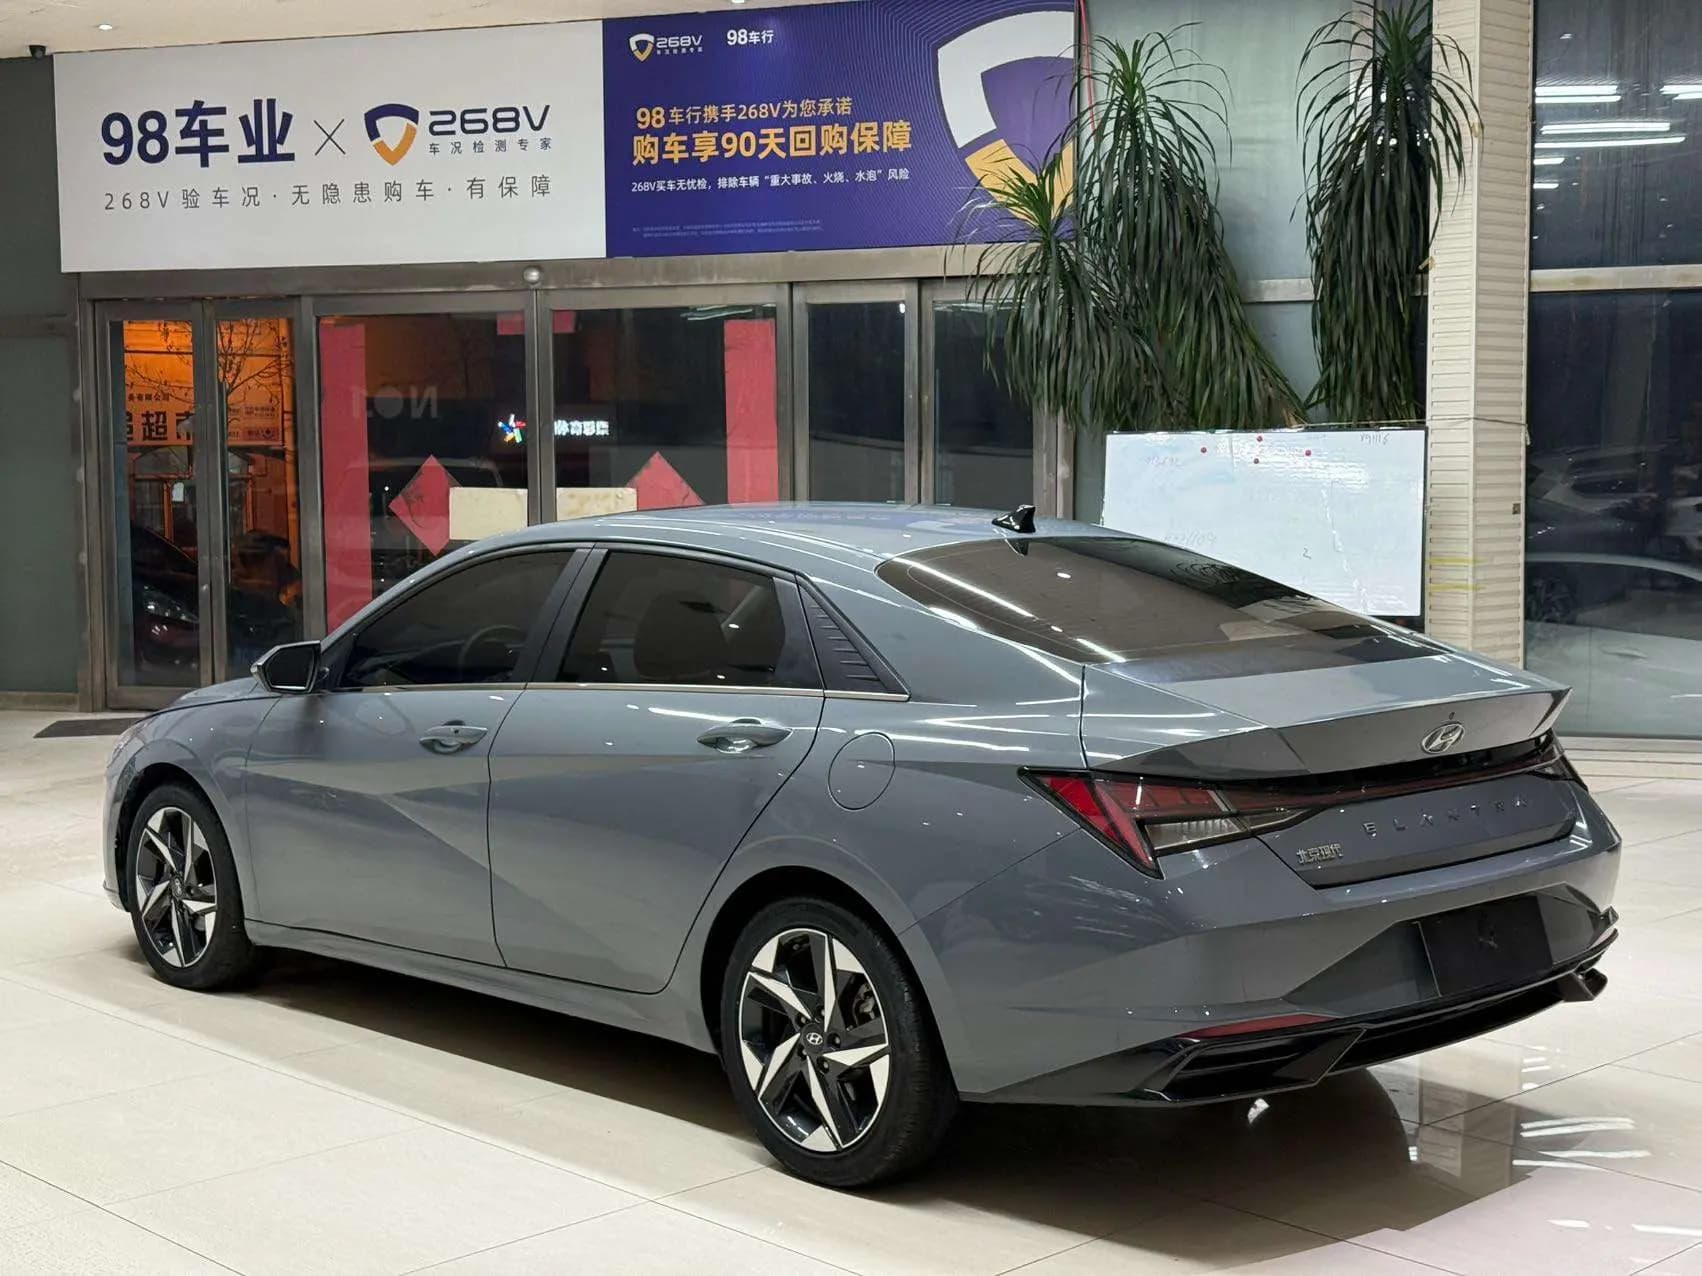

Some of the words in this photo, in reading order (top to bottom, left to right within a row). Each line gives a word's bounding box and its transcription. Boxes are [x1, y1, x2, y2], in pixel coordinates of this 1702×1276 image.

[656, 35, 703, 48] 268V
[726, 28, 775, 46] 98车行
[428, 104, 551, 137] 268V
[101, 98, 296, 168] 98车业
[632, 119, 912, 167] 购车享90天回购保障
[429, 137, 553, 156] 车况检测专家
[1296, 843, 1343, 865] 北京现代
